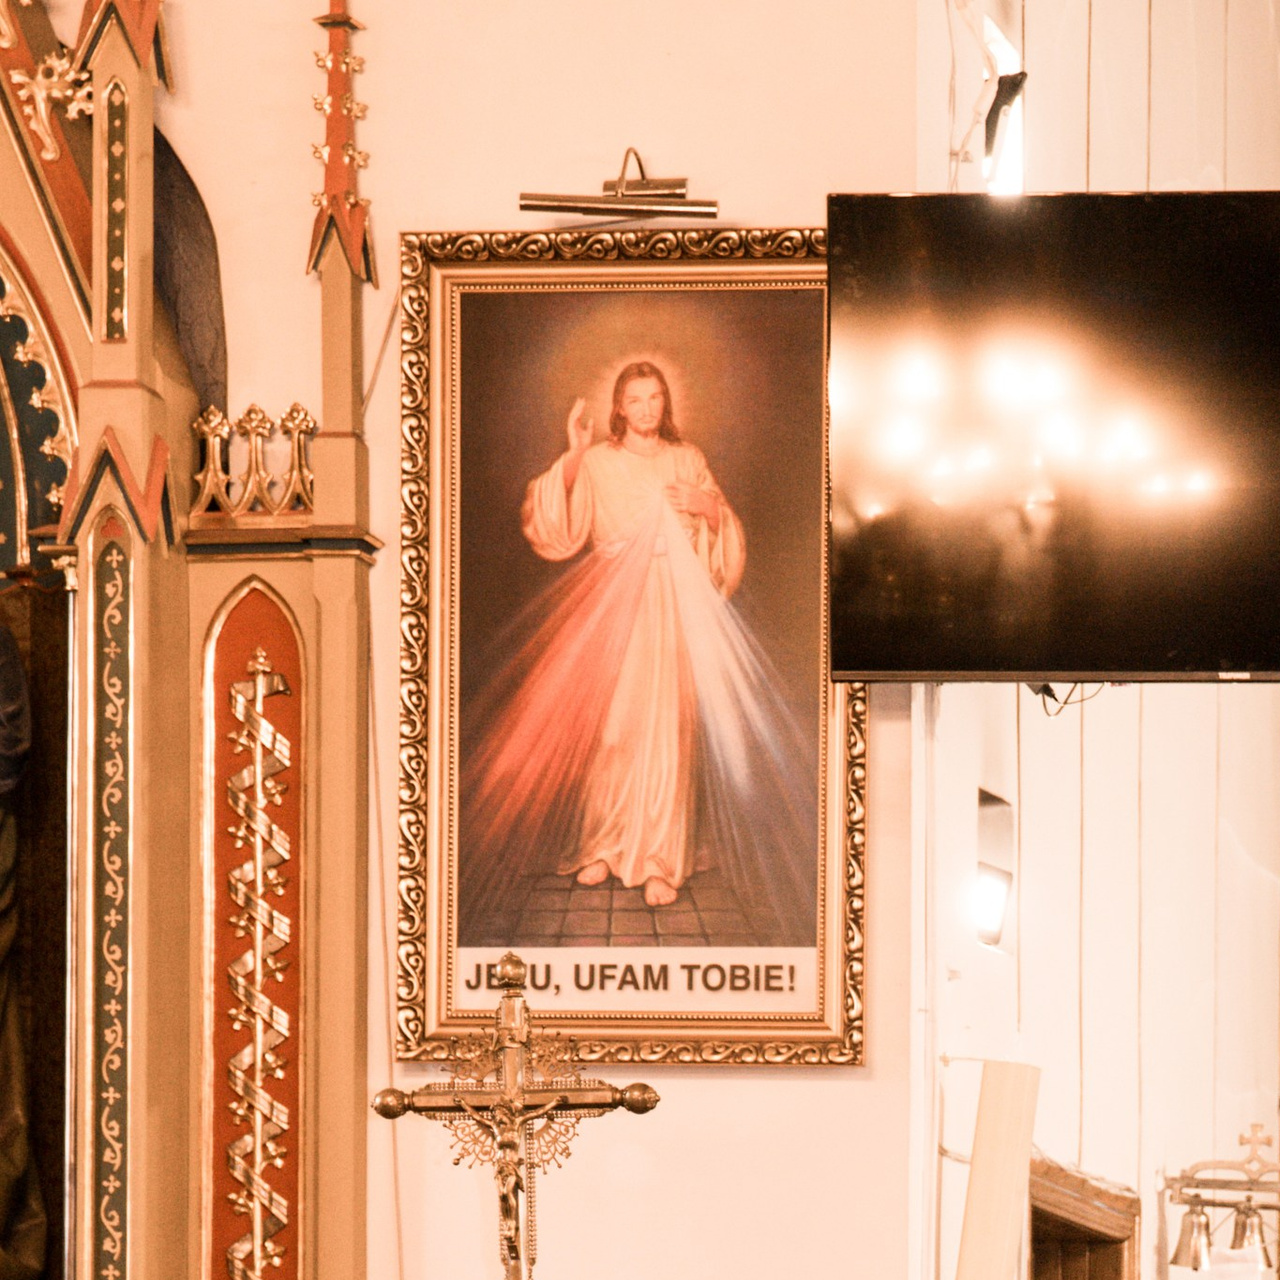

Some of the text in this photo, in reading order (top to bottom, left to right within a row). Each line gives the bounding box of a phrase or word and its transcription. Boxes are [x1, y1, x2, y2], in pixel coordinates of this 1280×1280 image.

[465, 963, 796, 996] JEU, UFAM TOBIE!
